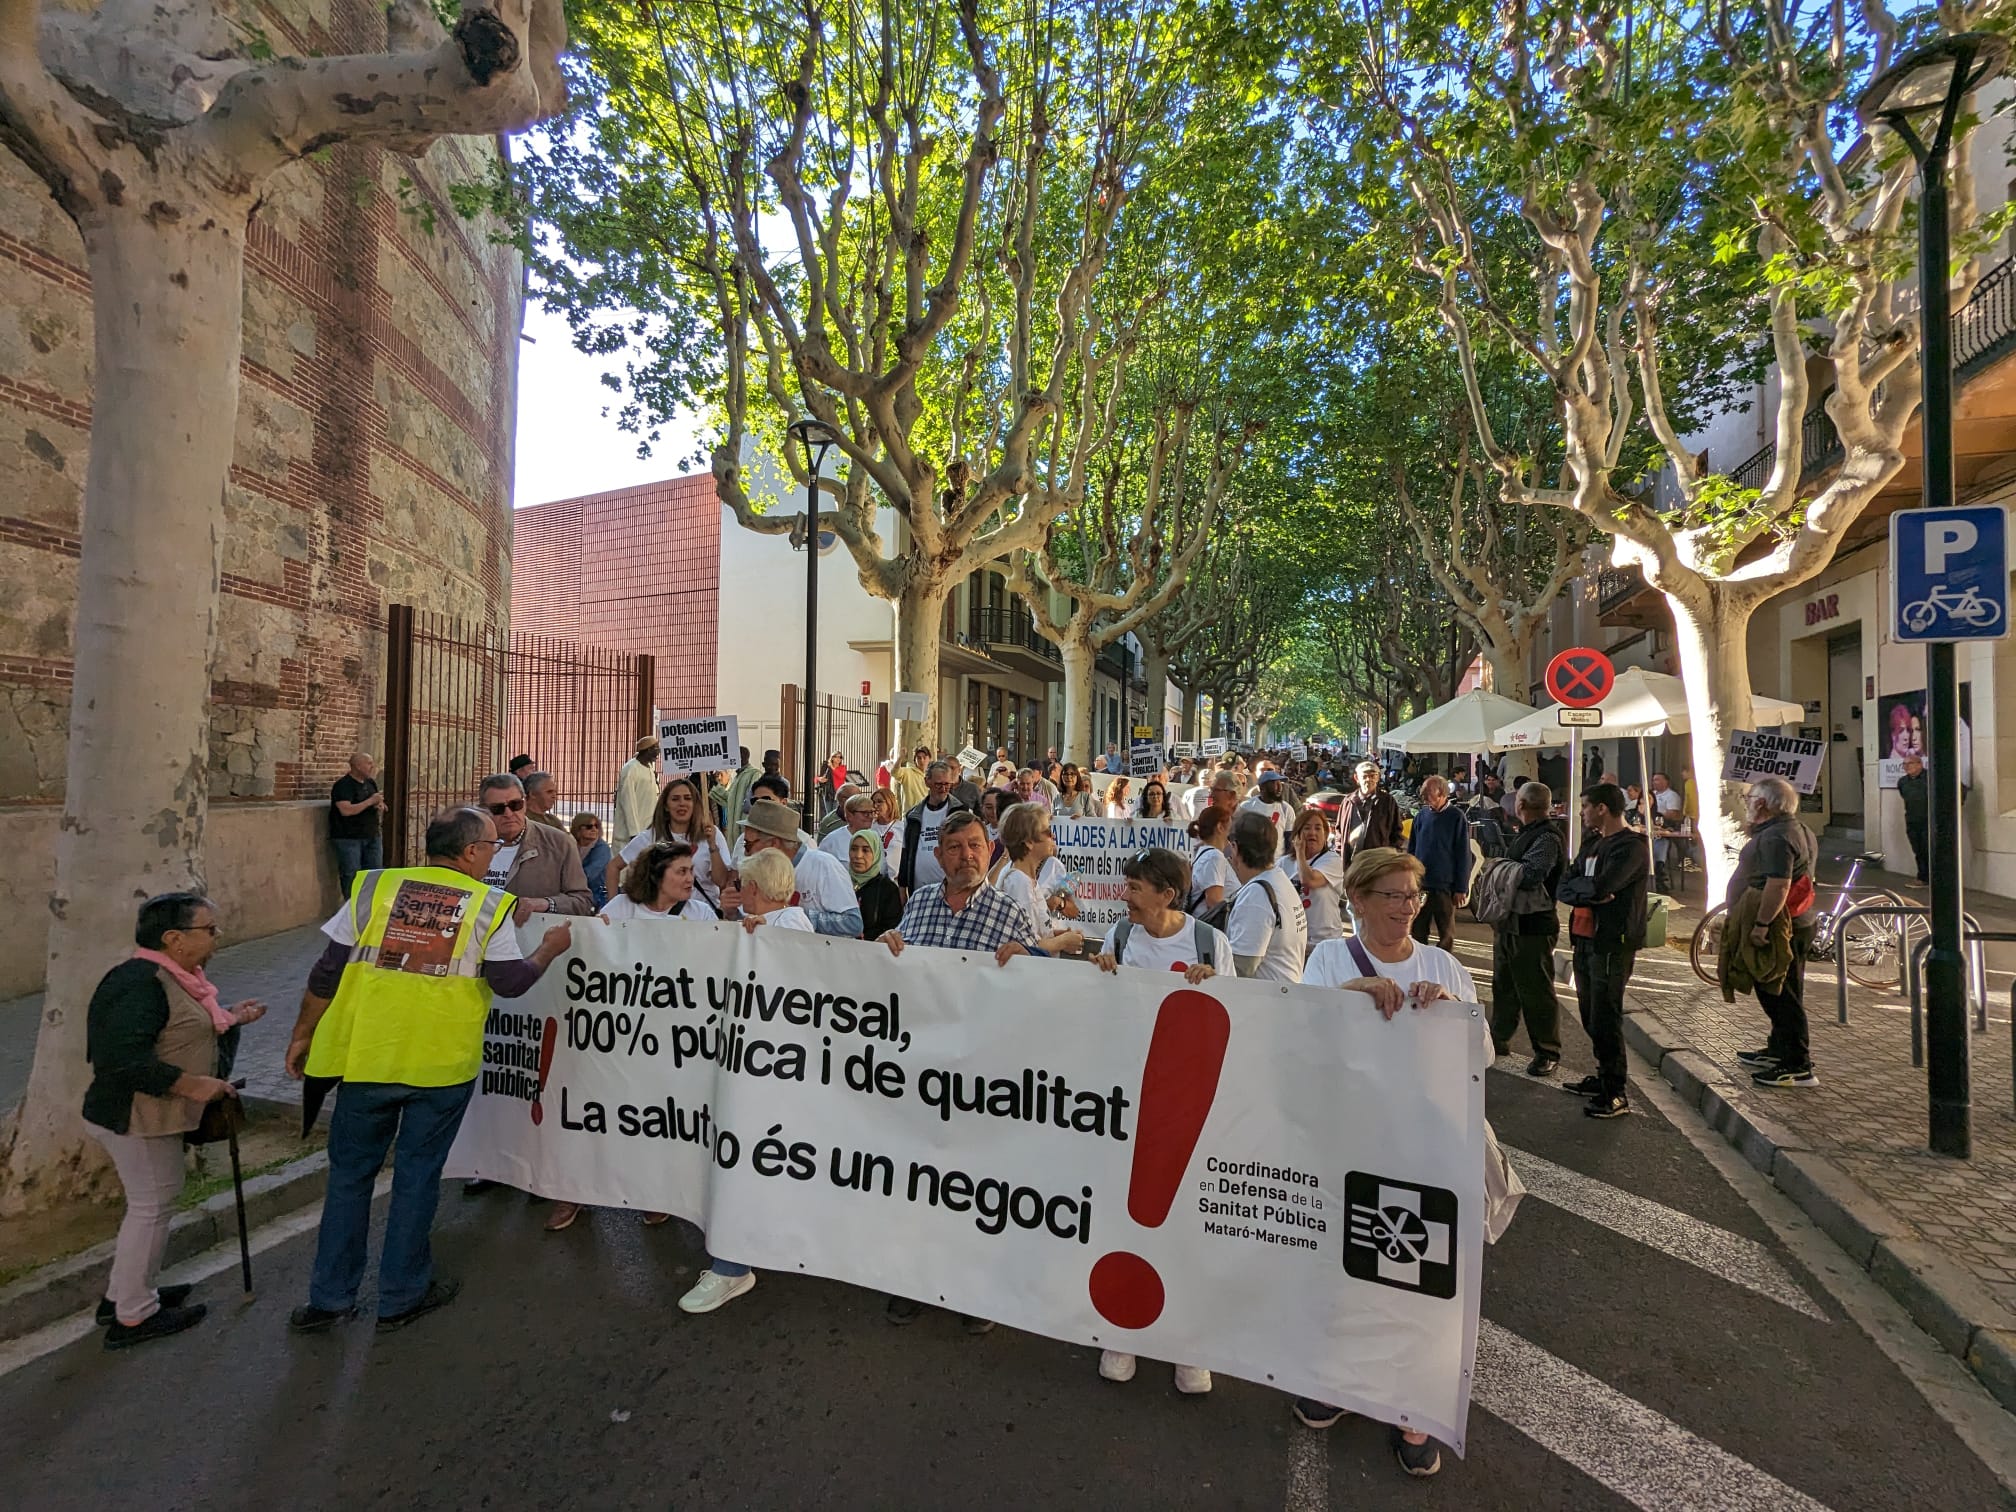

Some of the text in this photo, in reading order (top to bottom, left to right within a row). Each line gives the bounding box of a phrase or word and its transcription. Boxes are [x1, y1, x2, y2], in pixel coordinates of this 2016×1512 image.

[1925, 520, 1978, 574] P
[1805, 594, 1839, 626] BAR
[661, 720, 727, 738] potenciem
[675, 735, 686, 746] la
[1740, 735, 1753, 747] la
[1754, 733, 1822, 756] SANITAT
[1131, 755, 1154, 767] SANITAT
[1730, 745, 1746, 755] no
[1762, 750, 1779, 760] un
[1052, 824, 1106, 848] ALLADES
[1108, 827, 1118, 848] A
[1120, 827, 1136, 849] LA
[1097, 850, 1112, 876] els
[398, 892, 463, 918] Sanitat
[1087, 907, 1097, 923] de
[1098, 908, 1105, 924] la
[565, 957, 912, 1053] Sanitat universal,
[484, 1008, 542, 1042] Mou-te
[483, 1039, 541, 1073] sanitat
[565, 1005, 1131, 1142] 100% pública i de qualitat
[561, 1086, 608, 1135] La
[617, 1096, 711, 1149] salut
[752, 1123, 817, 1181] és
[829, 1147, 895, 1197] un
[907, 1161, 1093, 1244] negoci
[1206, 1157, 1319, 1189] Coordinadora
[1199, 1178, 1323, 1210] en Defensa de la
[1198, 1198, 1327, 1233] Sanitat Pública
[1204, 1221, 1318, 1251] Mataró-Maresme
